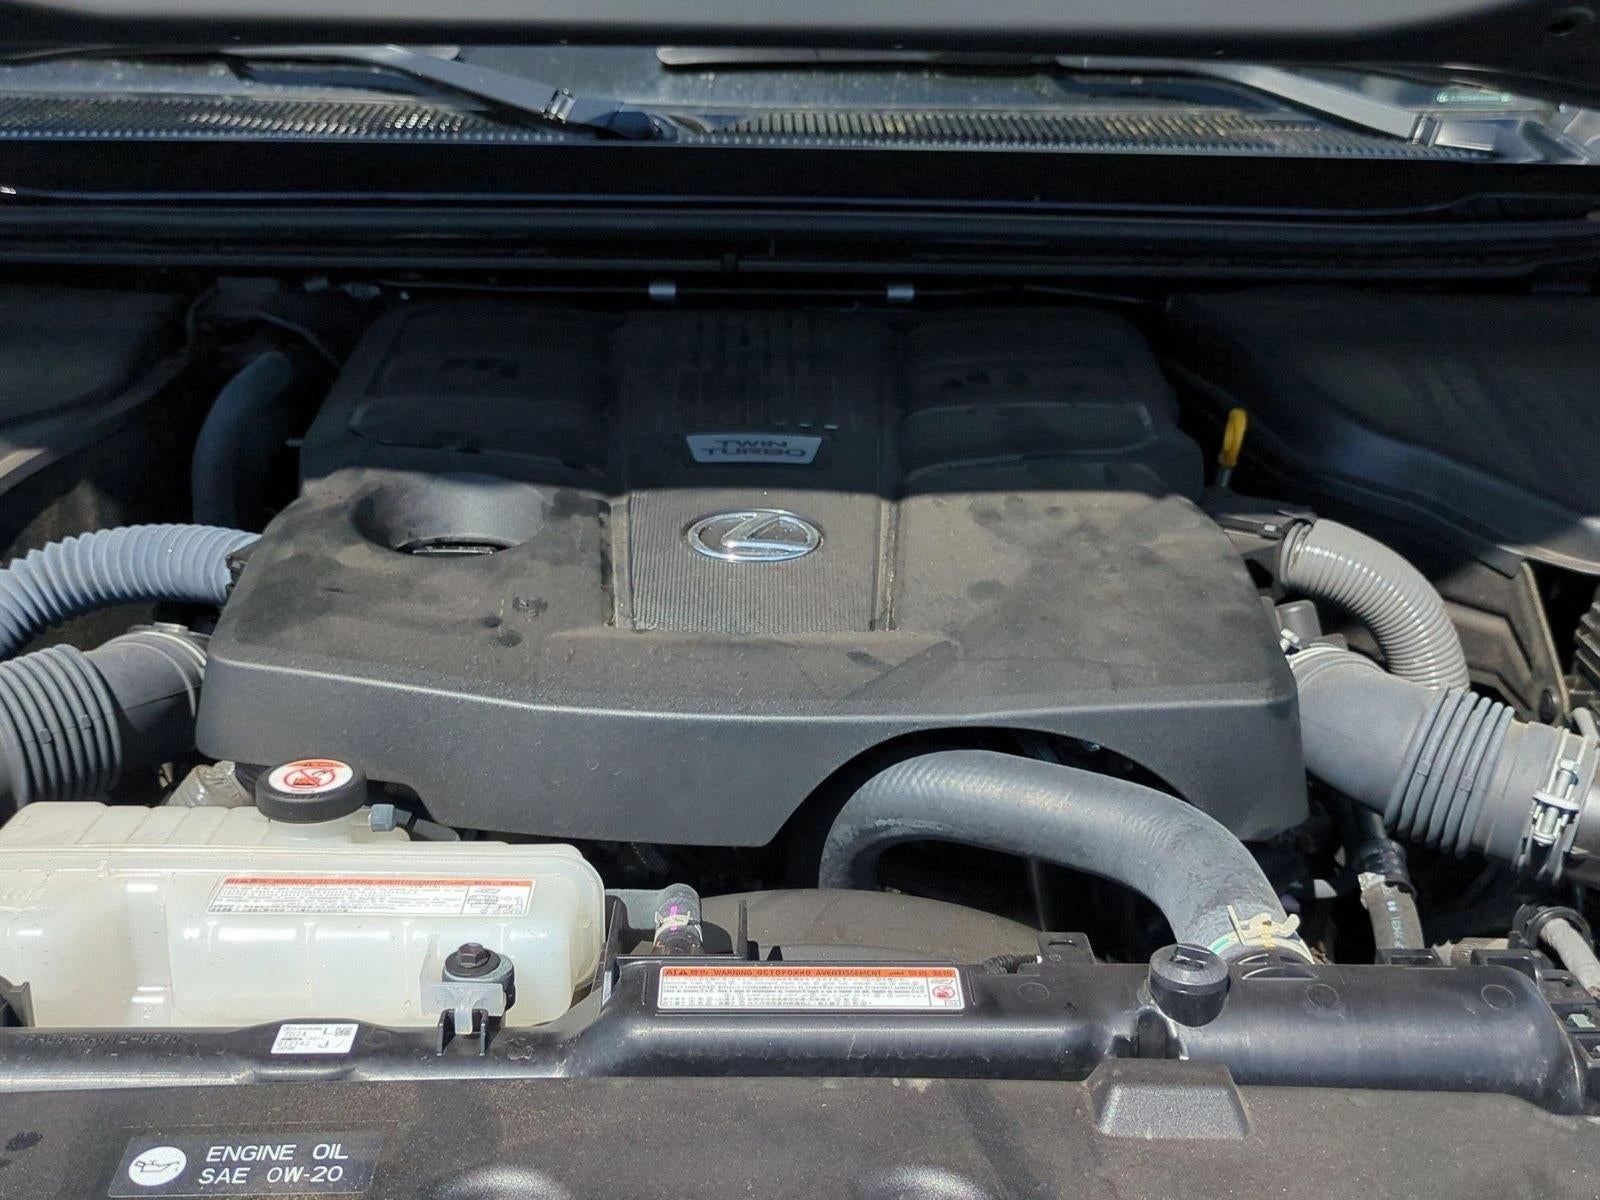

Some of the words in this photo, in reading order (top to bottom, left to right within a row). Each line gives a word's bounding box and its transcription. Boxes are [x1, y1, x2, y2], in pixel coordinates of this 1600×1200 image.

[713, 439, 788, 448] TWIN
[700, 447, 806, 457] TURBO
[713, 968, 753, 977] WARNING
[815, 968, 882, 977] AVERTISSEMENT
[205, 1143, 298, 1163] ENGINE
[312, 1143, 350, 1161] OIL
[197, 1167, 252, 1185] SAE
[265, 1165, 344, 1184] 0W-20
